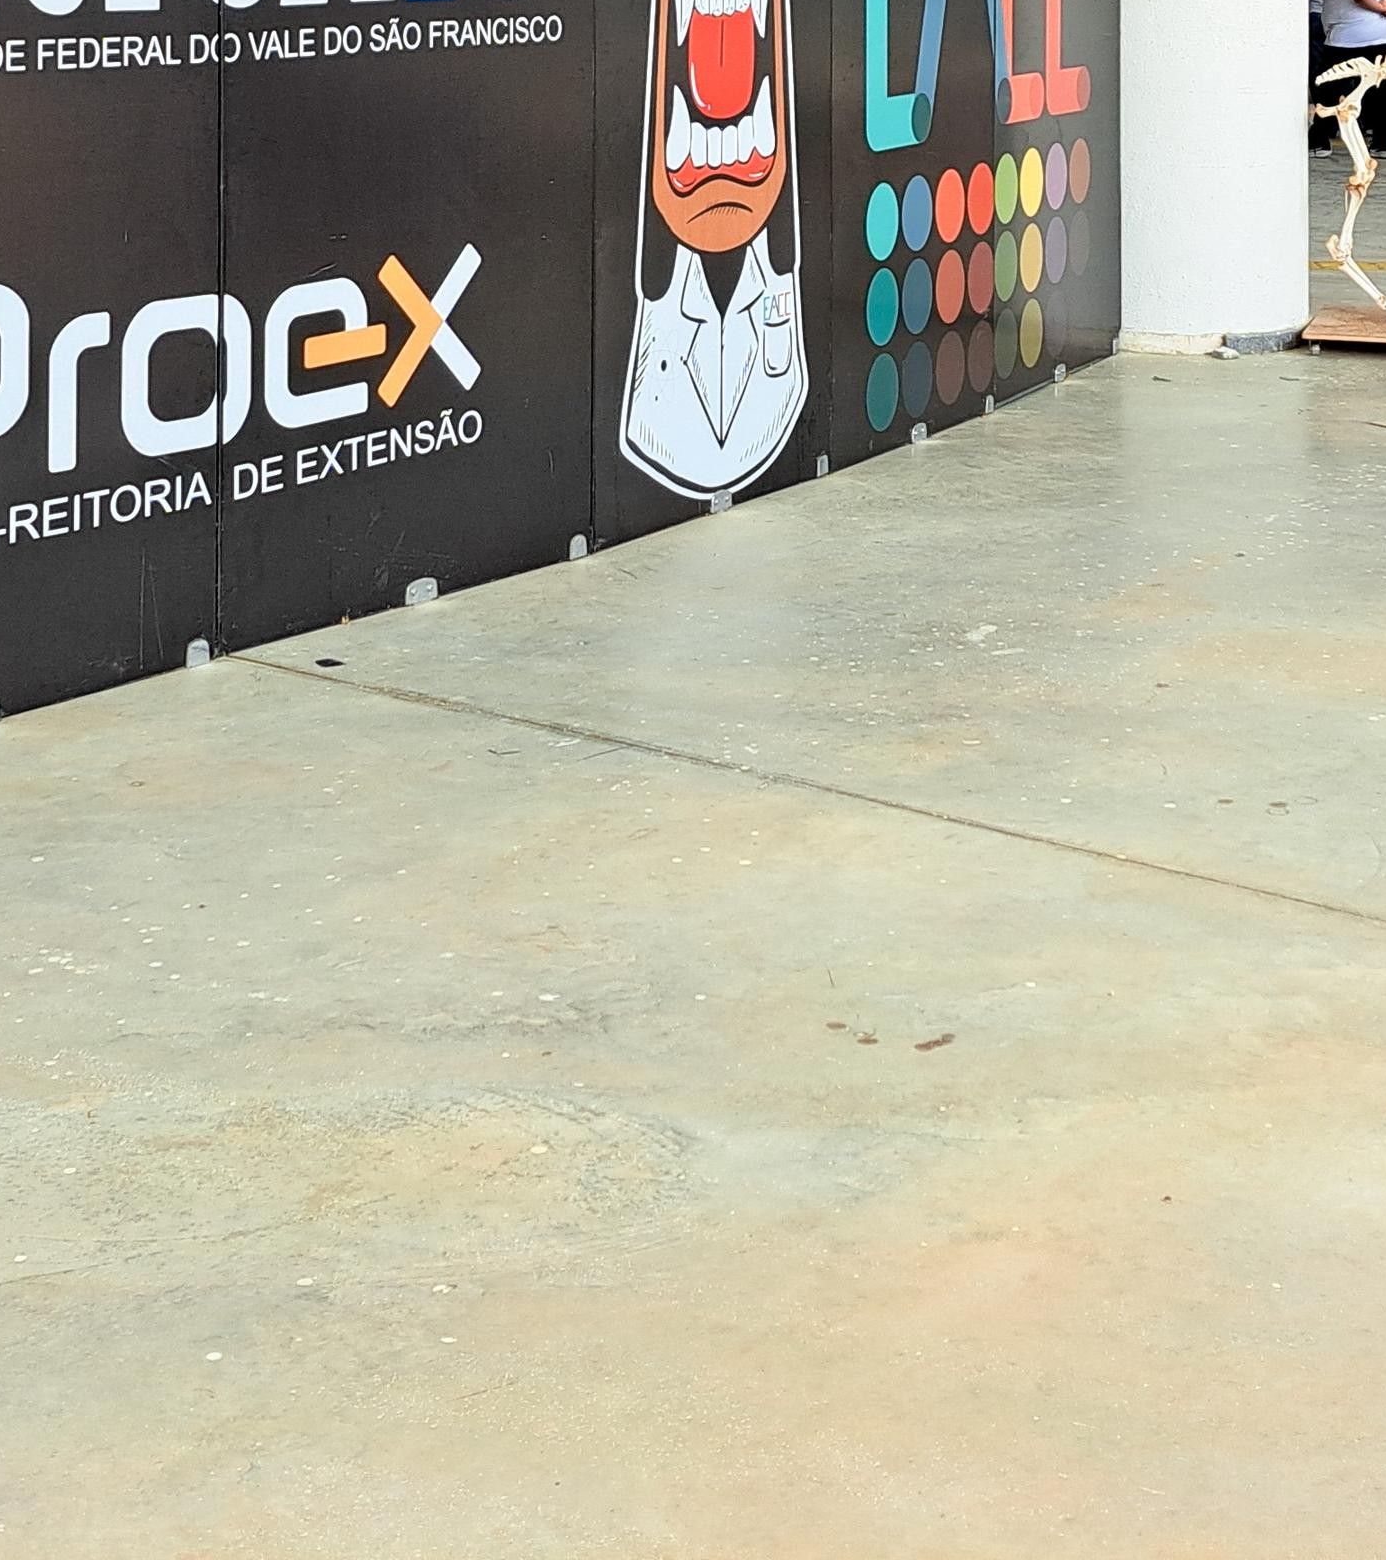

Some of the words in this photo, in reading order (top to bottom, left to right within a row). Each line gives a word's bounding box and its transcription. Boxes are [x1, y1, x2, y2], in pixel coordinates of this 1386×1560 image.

[37, 35, 182, 71] FEDERAL
[189, 32, 241, 65] DO
[247, 27, 316, 61] VALE
[323, 24, 363, 56] DO
[369, 17, 422, 53] SÃO
[428, 14, 563, 49] FRANCISCO
[233, 454, 284, 501] DE
[296, 408, 483, 485] EXTENSÃO
